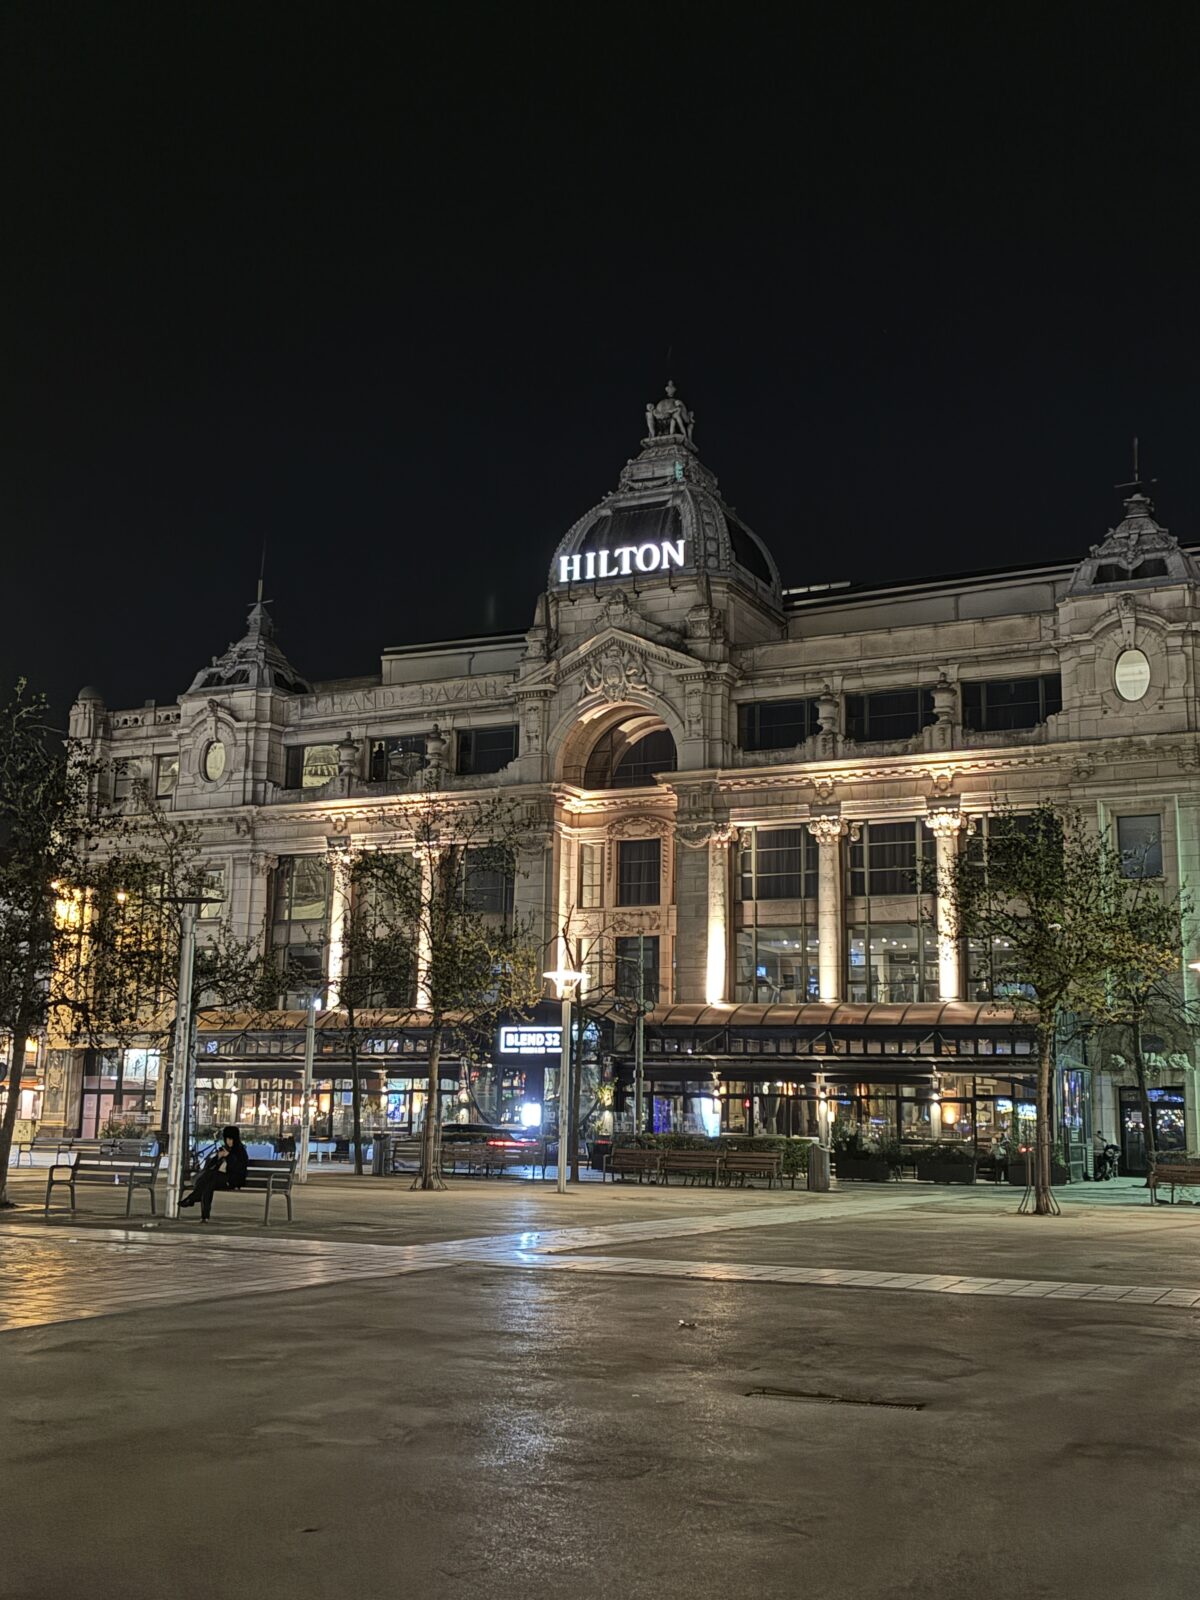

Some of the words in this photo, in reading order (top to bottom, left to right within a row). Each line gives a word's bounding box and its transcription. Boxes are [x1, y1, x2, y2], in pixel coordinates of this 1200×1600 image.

[559, 540, 685, 583] HILTON
[315, 690, 395, 713] GRAND
[421, 680, 497, 704] BAZAR
